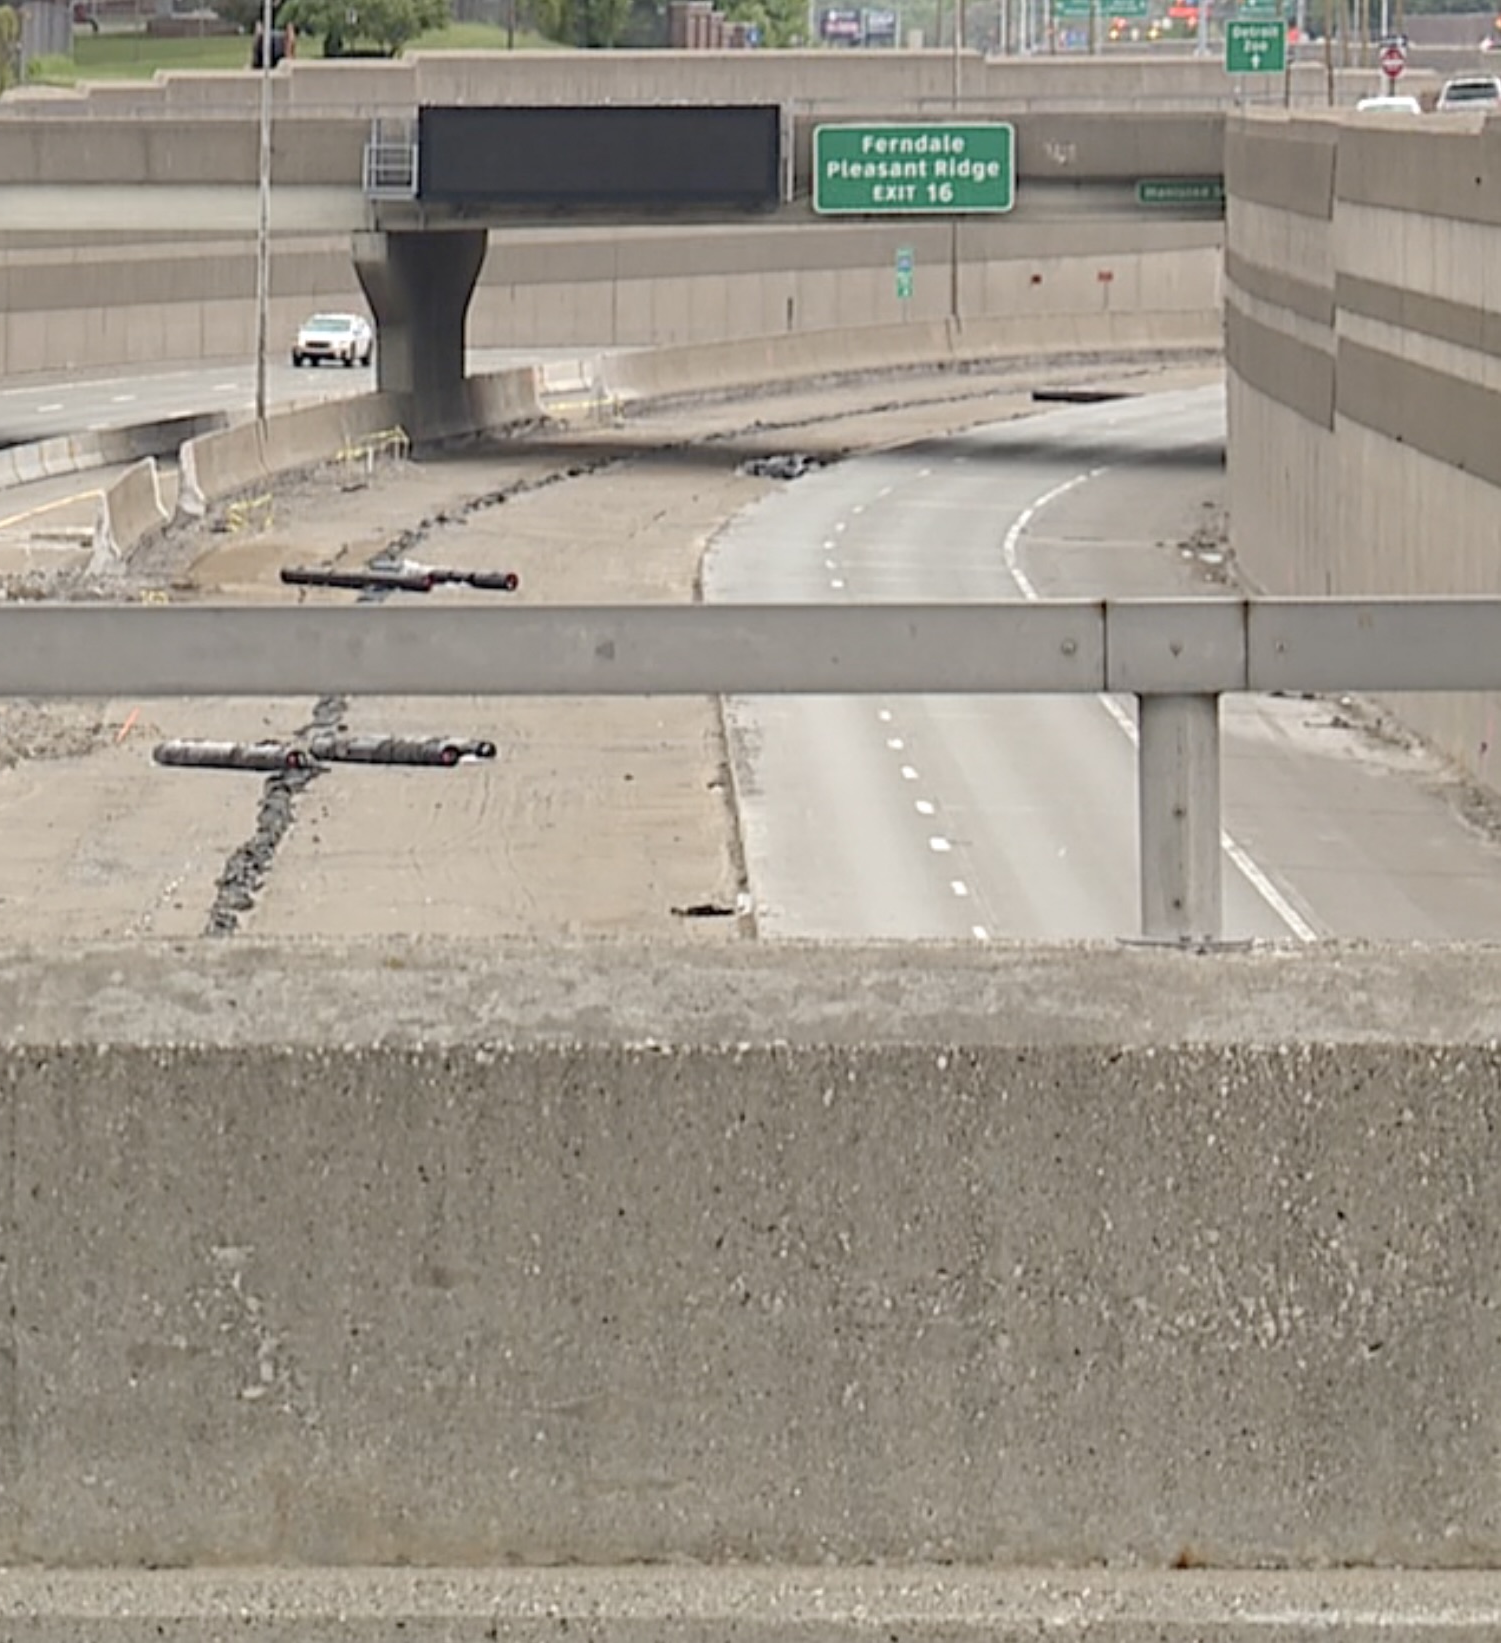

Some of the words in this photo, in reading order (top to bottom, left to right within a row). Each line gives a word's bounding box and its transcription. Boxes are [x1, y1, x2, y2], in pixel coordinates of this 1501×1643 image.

[1232, 26, 1279, 39] Detroit
[1243, 40, 1269, 53] Zoo
[861, 134, 965, 154] Ferndale
[826, 159, 927, 179] Pleasant
[935, 158, 1001, 182] Ridge
[872, 184, 917, 202] EXIT
[927, 182, 954, 203] 16
